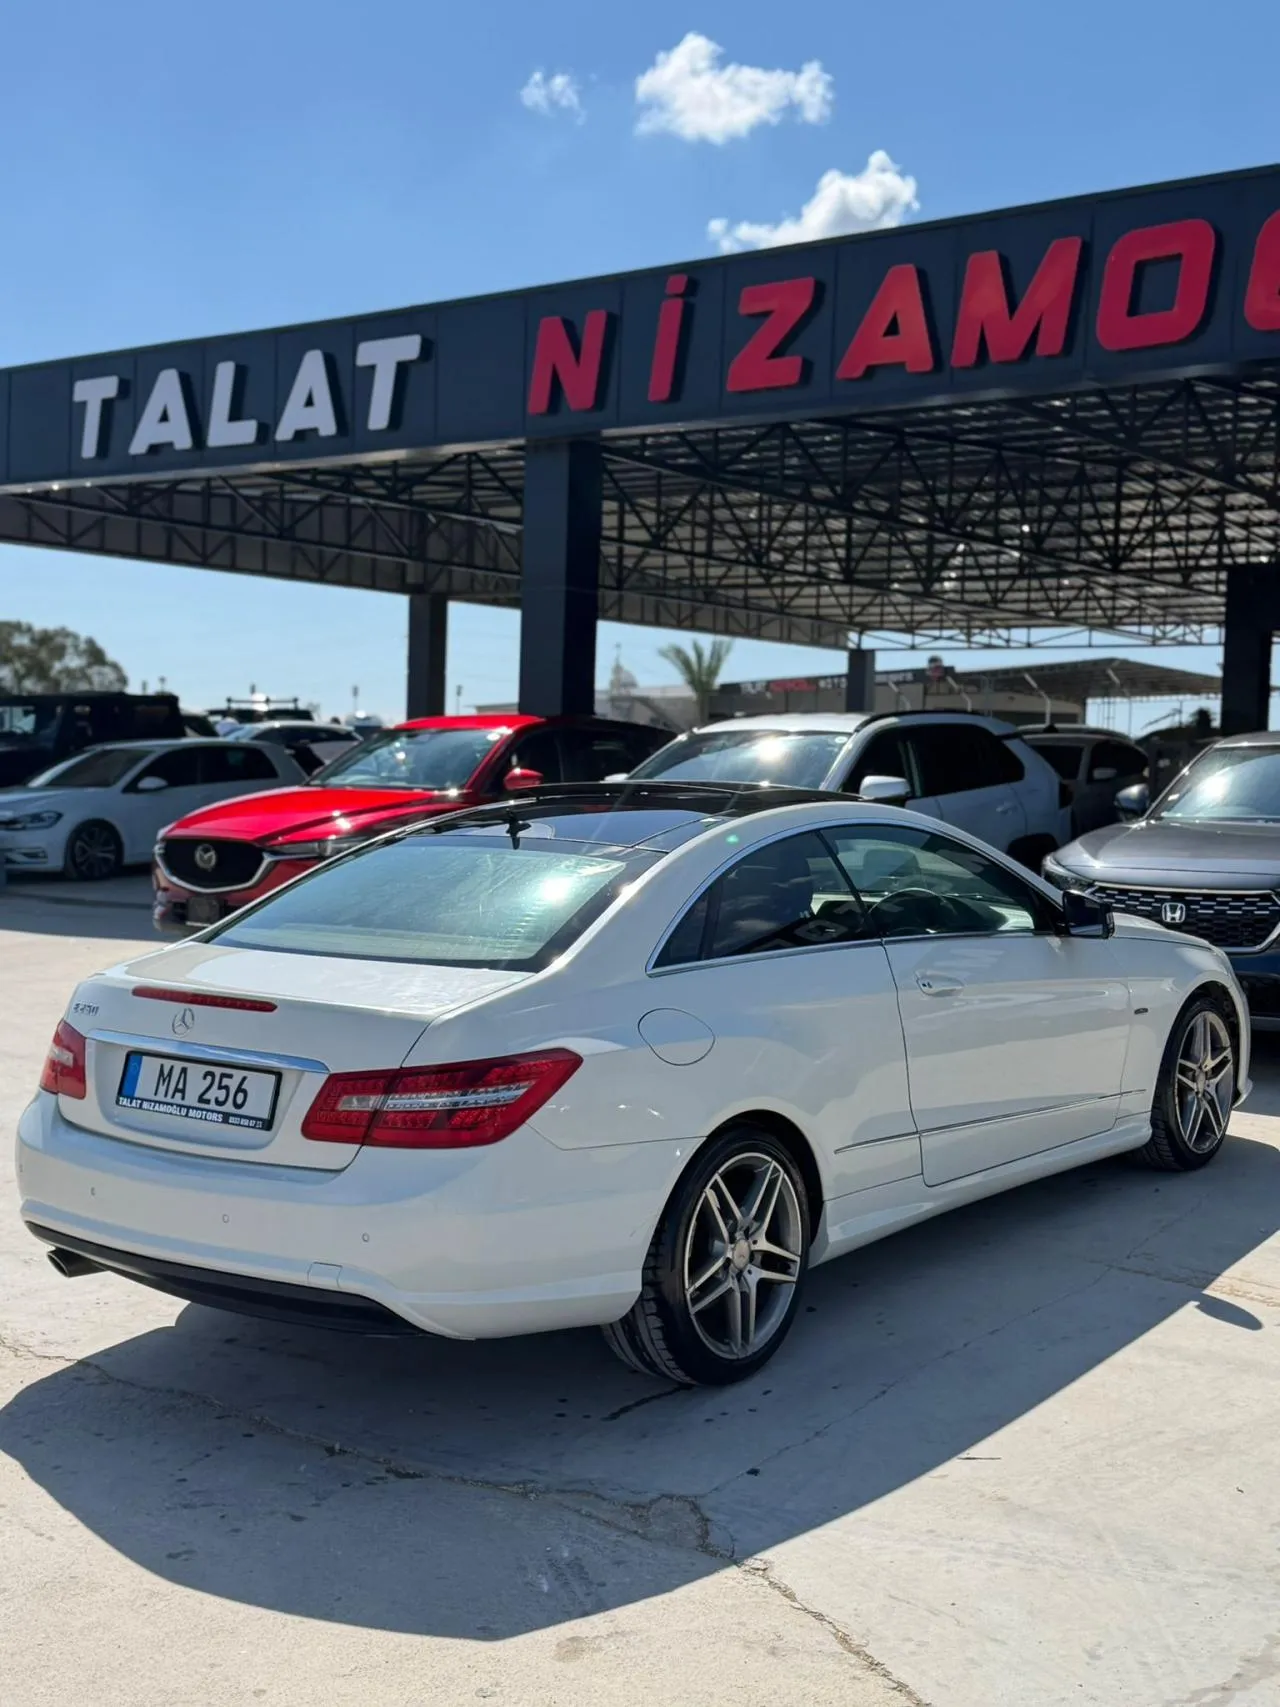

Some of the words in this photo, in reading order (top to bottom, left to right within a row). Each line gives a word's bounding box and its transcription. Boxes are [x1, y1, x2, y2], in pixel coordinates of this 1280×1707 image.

[73, 334, 422, 459] TALAT
[119, 1097, 141, 1109] TALAT
[188, 1109, 223, 1123] MOTORS
[154, 1063, 188, 1101] MA
[197, 1070, 249, 1110] 256
